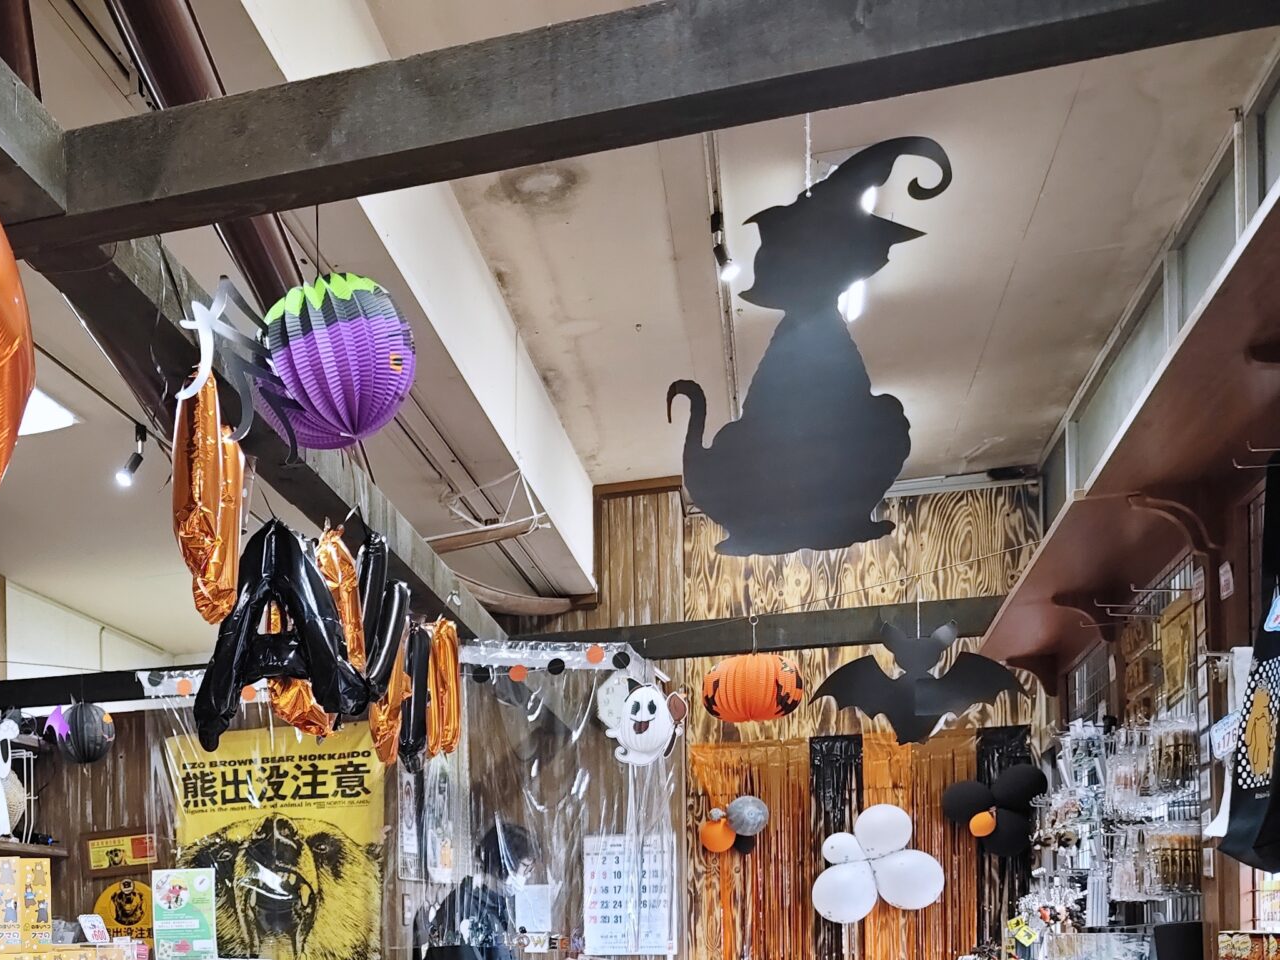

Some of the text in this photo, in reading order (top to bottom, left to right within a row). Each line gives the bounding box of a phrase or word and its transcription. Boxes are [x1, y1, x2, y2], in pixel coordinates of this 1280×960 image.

[182, 750, 371, 770] EZO BROWN BEAR HOKKAIDO
[182, 761, 372, 808] 熊出没注意
[613, 871, 622, 879] 10
[613, 886, 622, 894] 17
[613, 901, 622, 909] 24
[613, 915, 622, 923] 31
